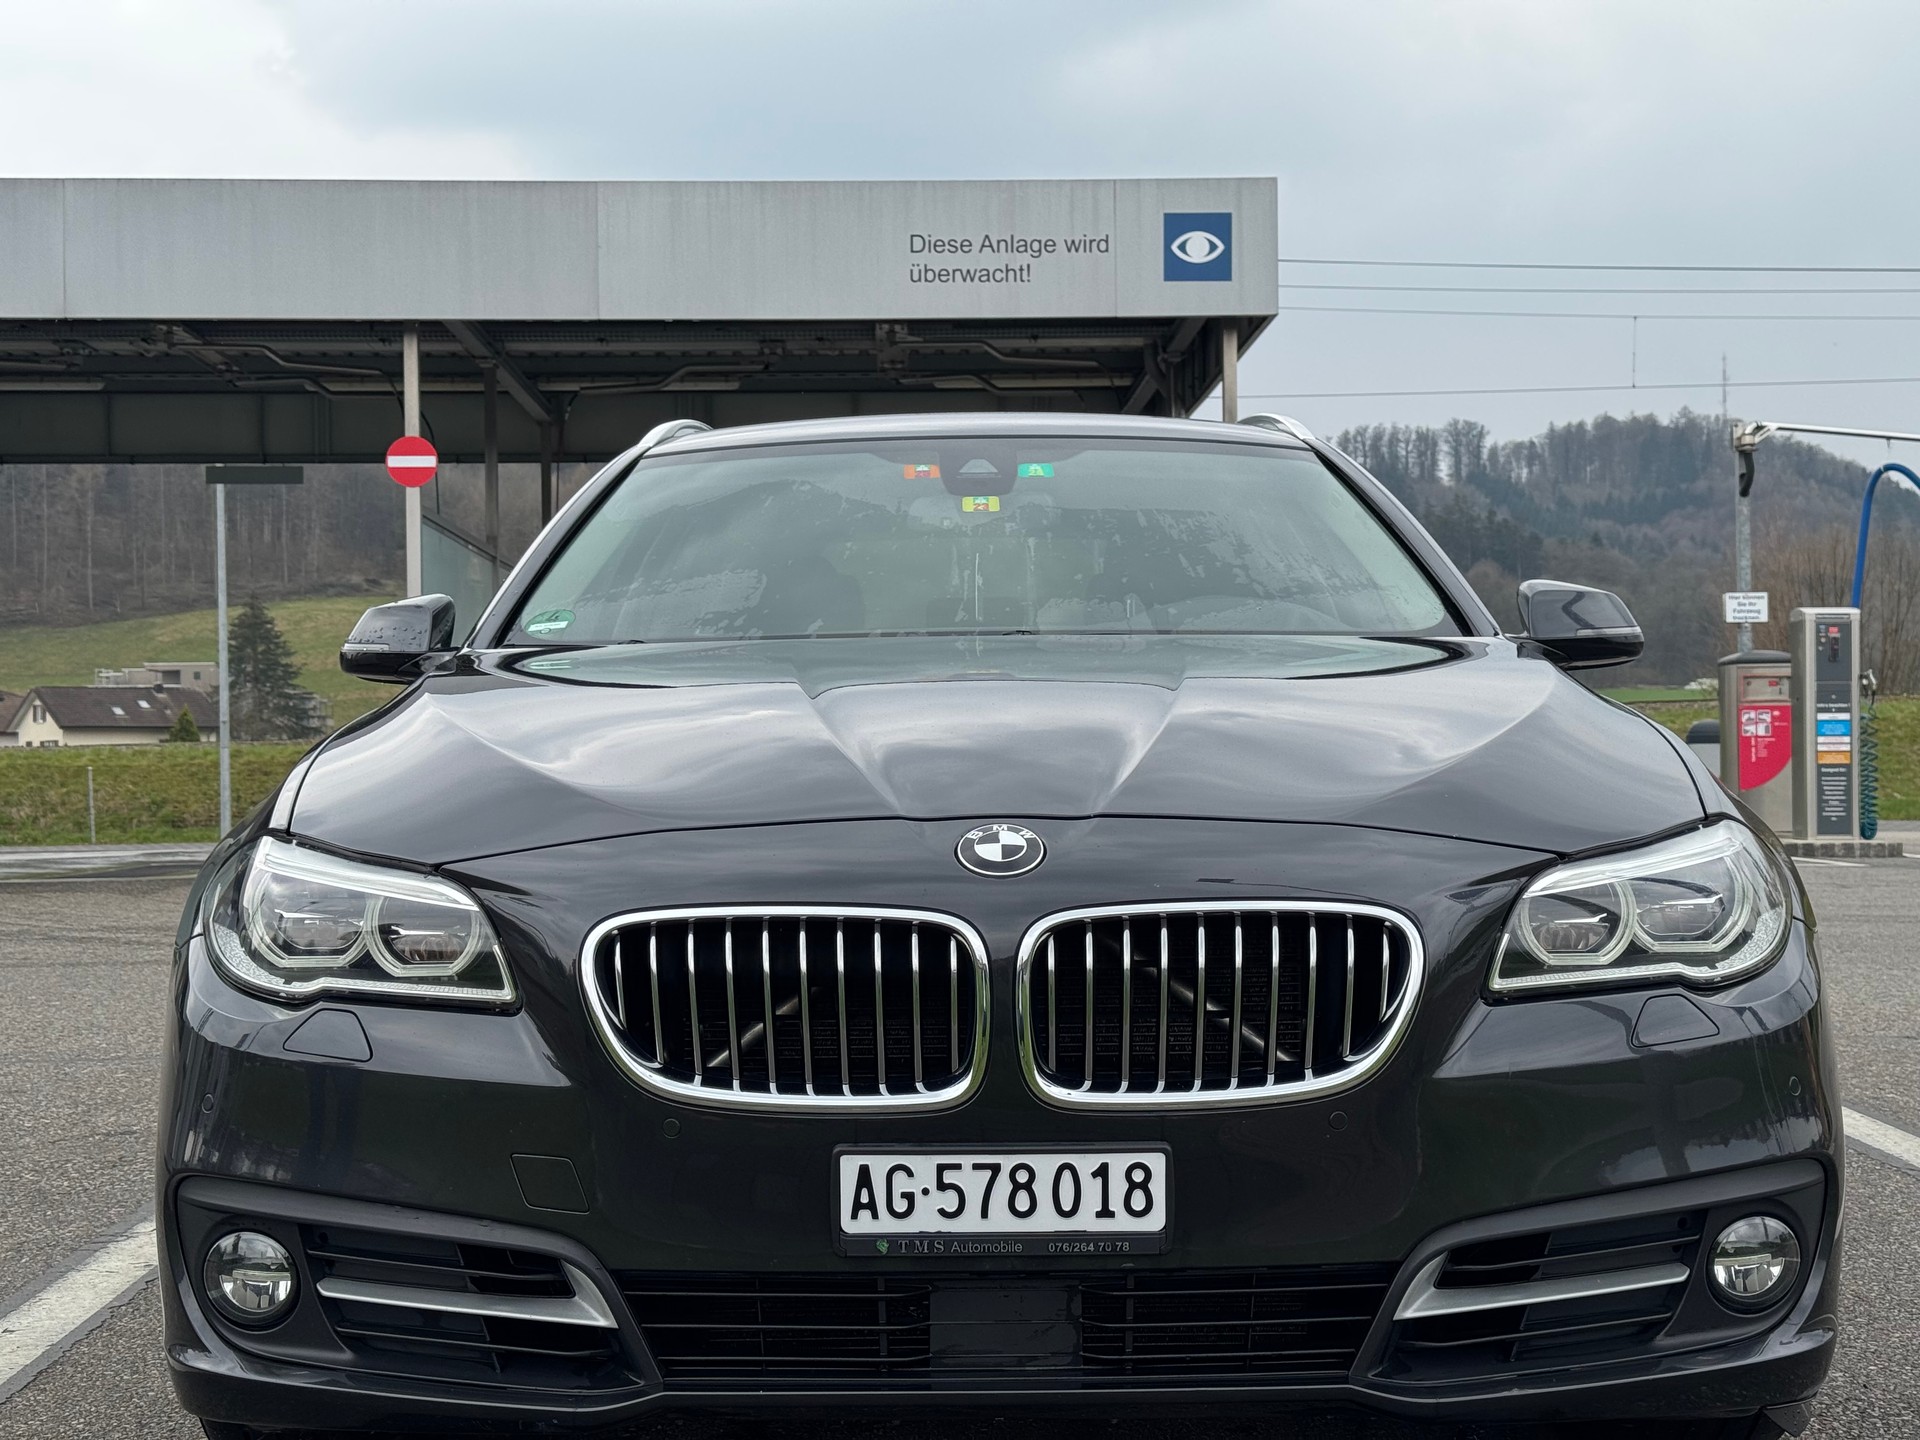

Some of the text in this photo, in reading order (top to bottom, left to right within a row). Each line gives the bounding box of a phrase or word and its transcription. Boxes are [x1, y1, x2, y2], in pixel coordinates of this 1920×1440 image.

[909, 234, 1110, 259] Diese Anlage wird
[909, 263, 1032, 283] überwacht!
[966, 824, 1036, 840] BMW
[950, 1240, 1024, 1254] Automobile
[1047, 1241, 1096, 1254] 076/264
[1097, 1241, 1113, 1253] 70
[1115, 1240, 1131, 1253] 78
